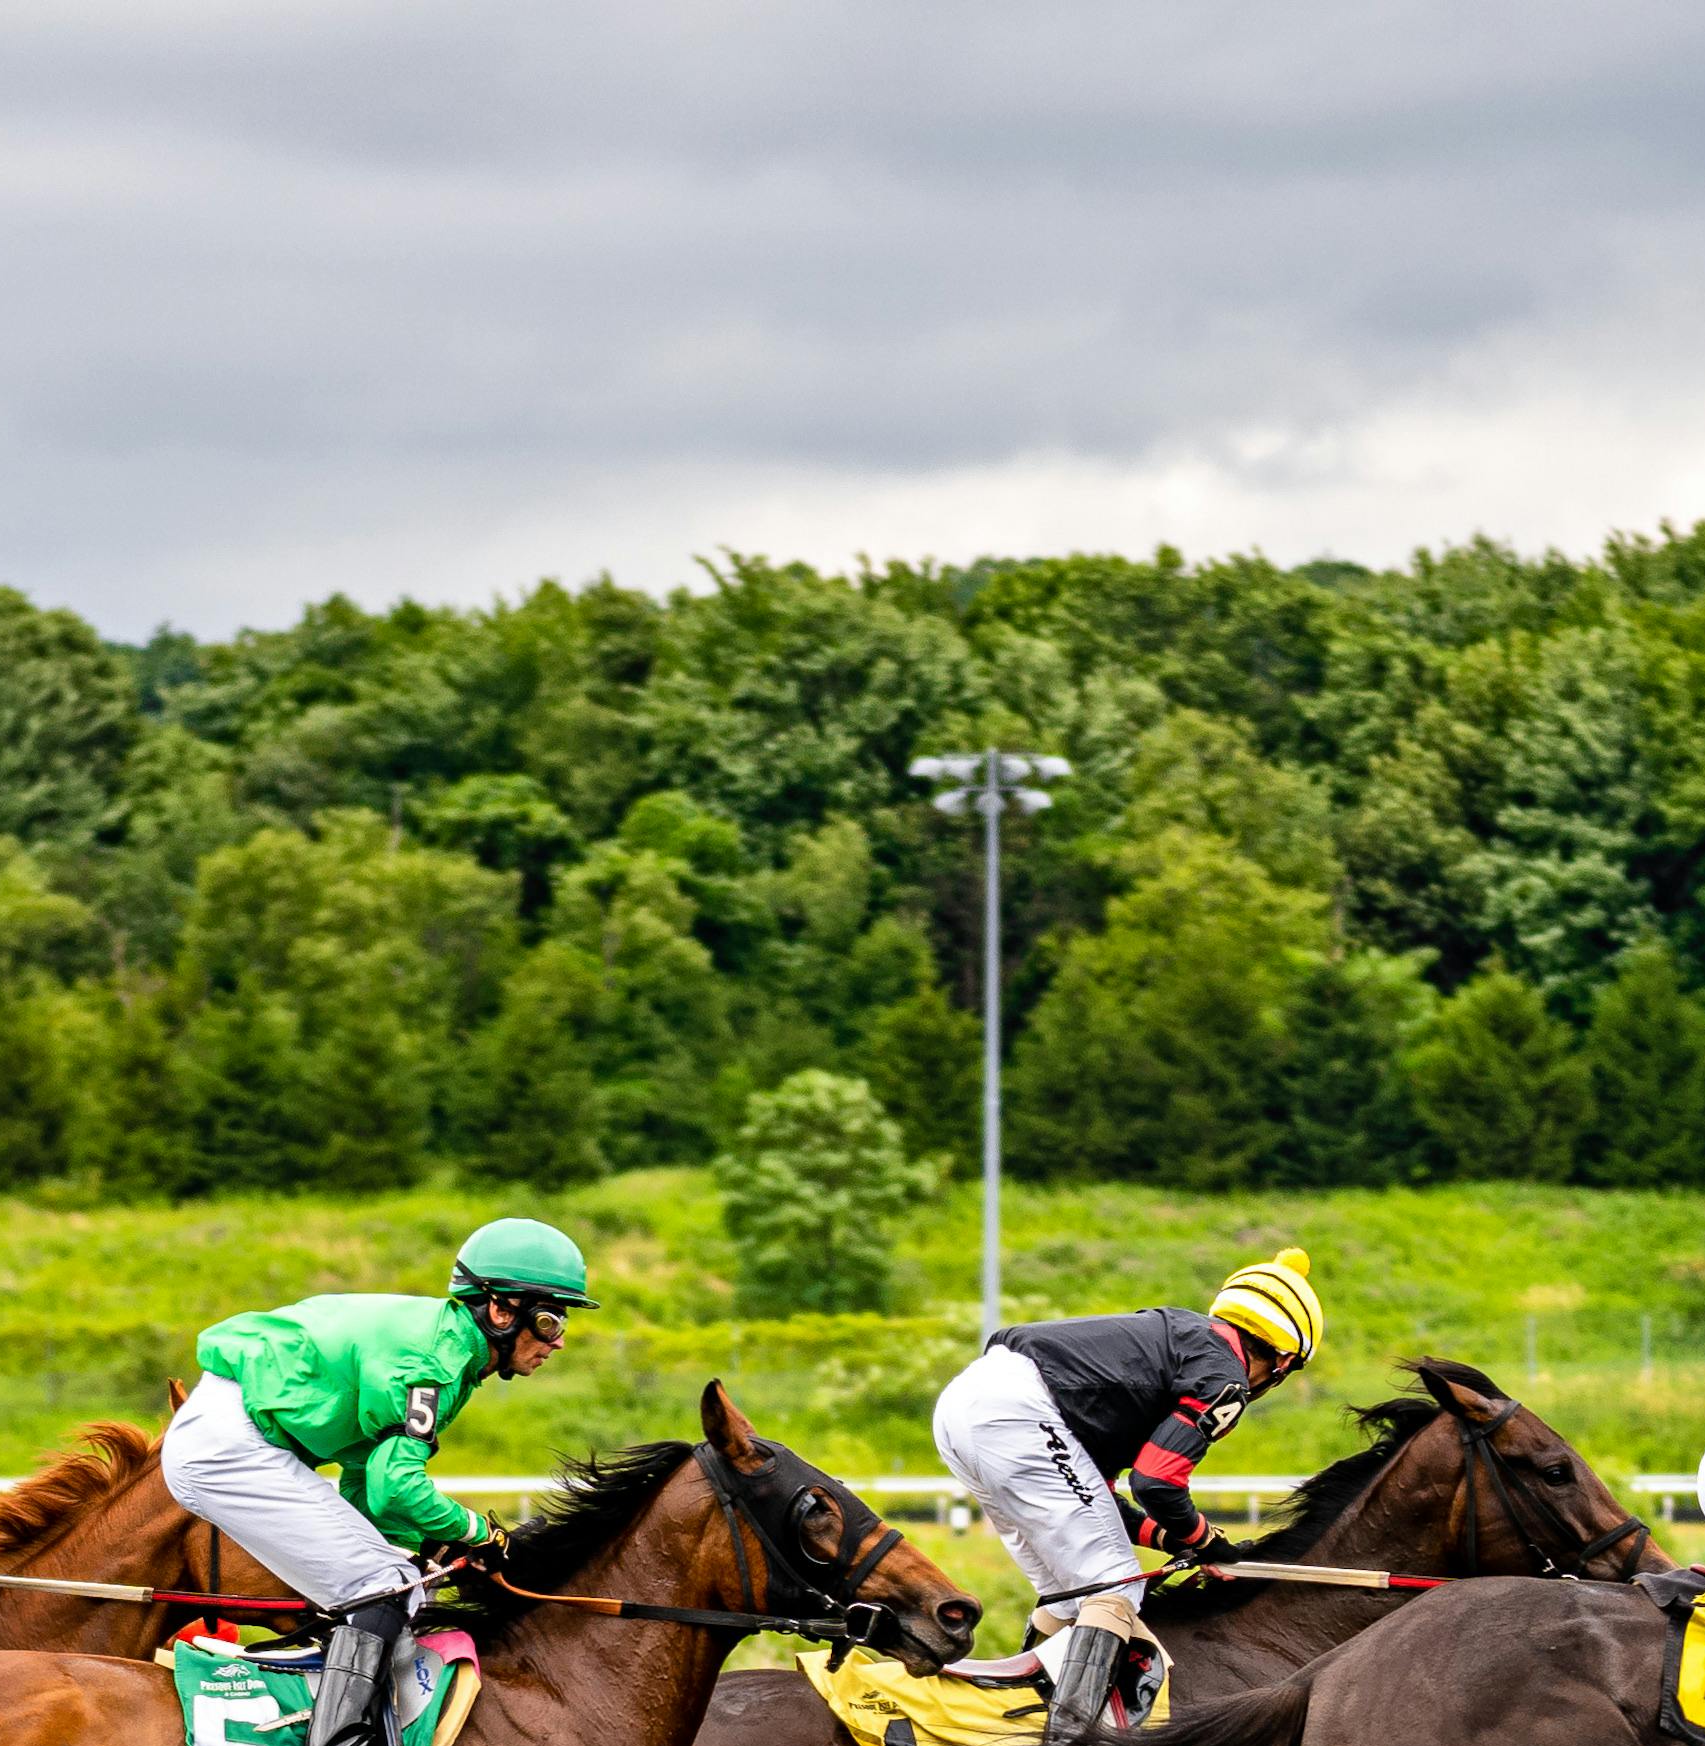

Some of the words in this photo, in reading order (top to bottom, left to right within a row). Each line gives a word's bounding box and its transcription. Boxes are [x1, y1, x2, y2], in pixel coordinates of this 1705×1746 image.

[409, 1387, 435, 1434] 5
[1211, 1401, 1242, 1438] 4
[414, 1656, 434, 1696] FOX
